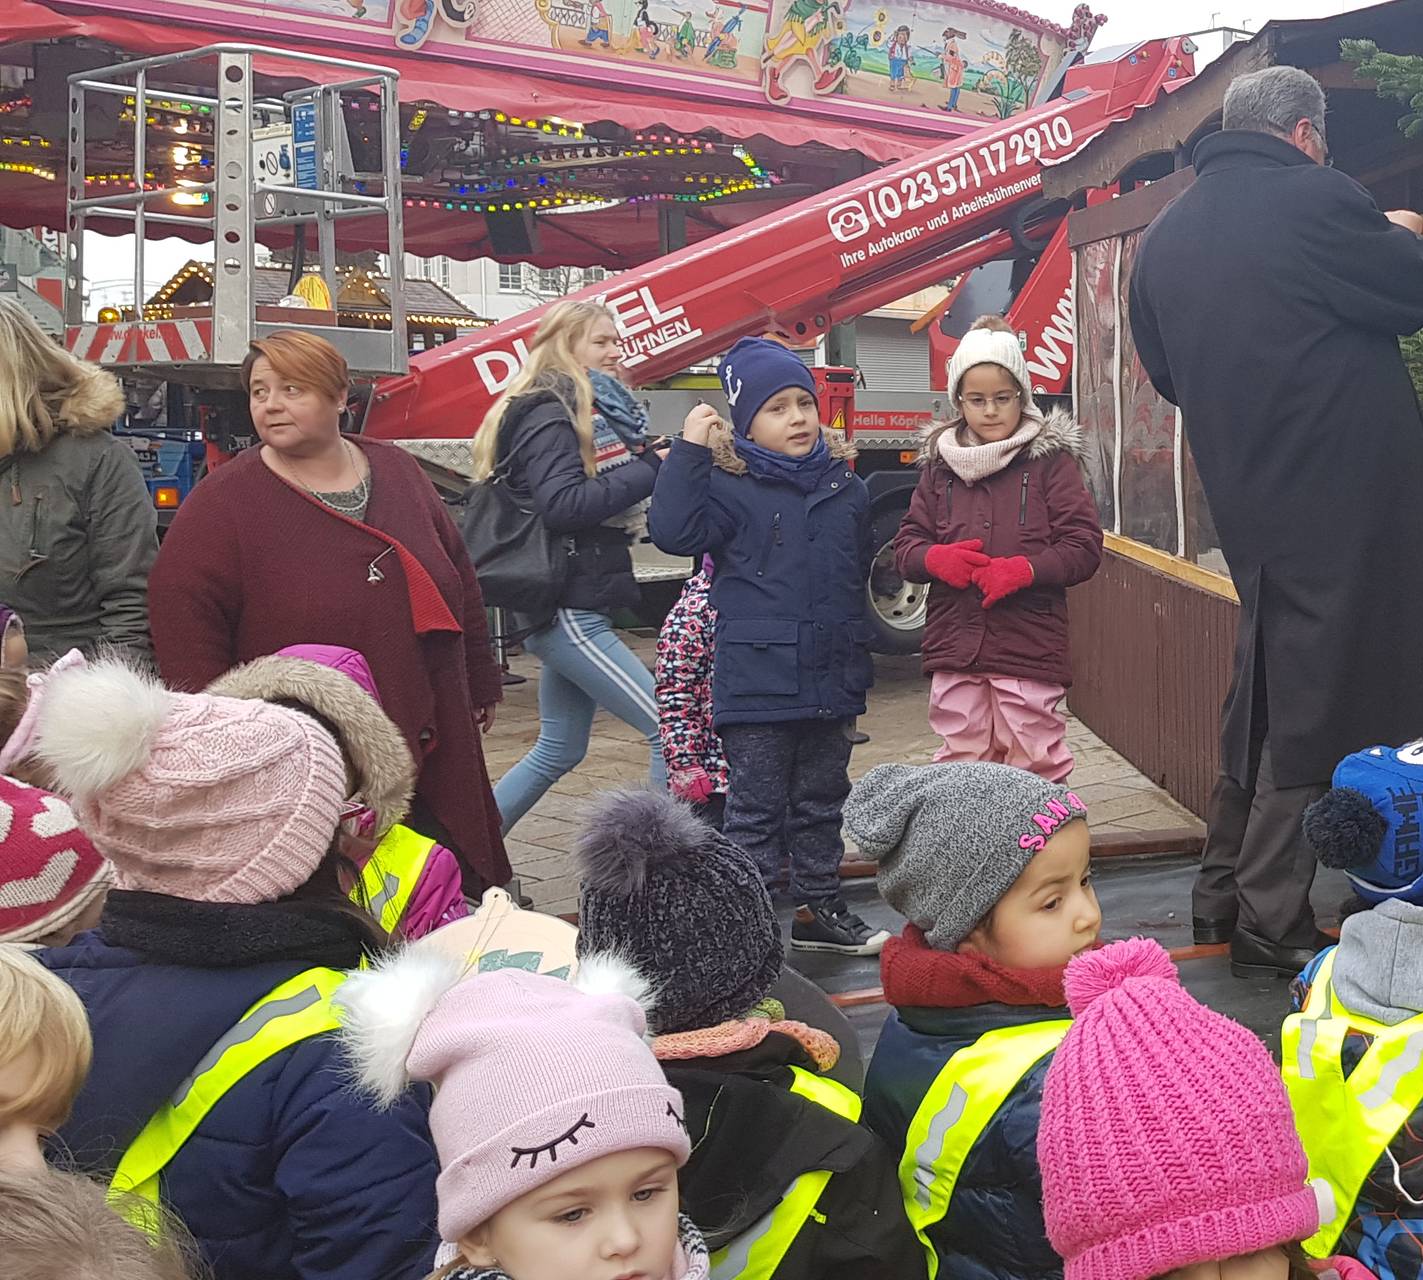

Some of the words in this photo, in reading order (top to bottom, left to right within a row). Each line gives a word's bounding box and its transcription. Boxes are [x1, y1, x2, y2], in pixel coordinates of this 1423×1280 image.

[840, 247, 866, 268] Ihre
[868, 225, 924, 256] Autokran-
[927, 210, 949, 231] und
[853, 414, 886, 426] Helle
[889, 414, 921, 429] Köpf
